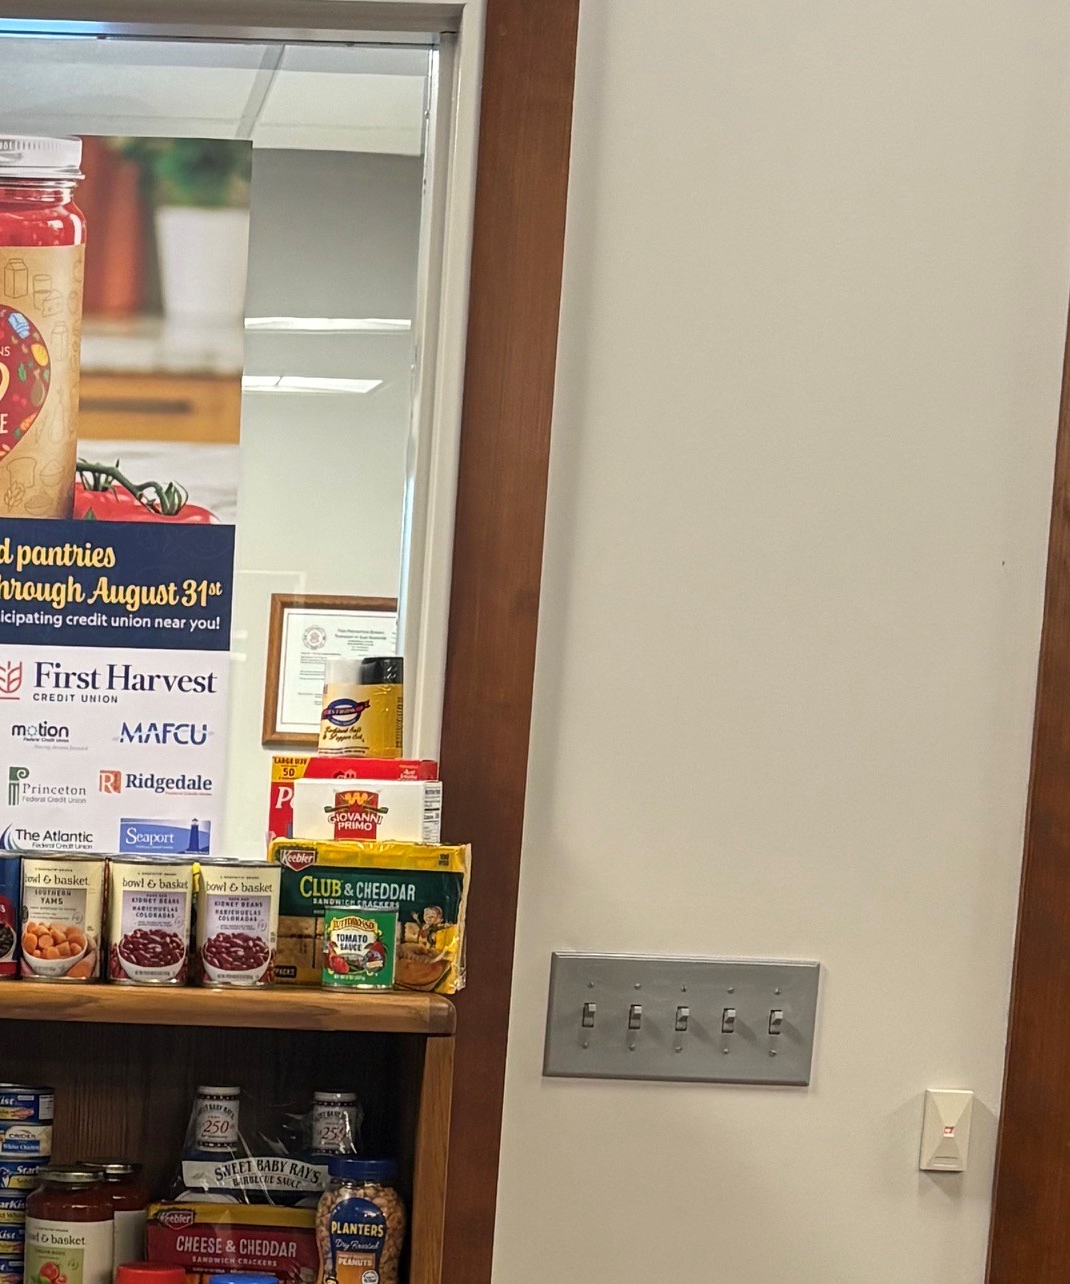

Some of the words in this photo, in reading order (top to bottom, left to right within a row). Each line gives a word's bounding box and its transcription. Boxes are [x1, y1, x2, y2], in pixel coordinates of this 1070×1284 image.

[16, 542, 116, 572] pantries
[87, 576, 179, 612] August
[66, 612, 107, 627] credit
[111, 614, 151, 628] union
[154, 617, 186, 629] near
[190, 617, 220, 632] you!
[34, 661, 102, 690] First
[106, 663, 218, 694] Harvest
[32, 692, 75, 702] CREDIT
[82, 694, 118, 704] UNION
[12, 721, 69, 738] motion
[119, 721, 209, 746] MAFCU
[22, 783, 87, 796] Princeton
[126, 773, 212, 793] Ridgedale
[328, 813, 383, 825] GIOVANNI
[338, 822, 373, 831] PRIMO
[15, 828, 39, 842] The
[42, 829, 93, 843] Atlantic
[126, 827, 173, 845] Seaport
[300, 876, 341, 897] CLUB
[344, 884, 354, 897] &
[356, 882, 416, 901] CHEDDAR
[336, 933, 368, 943] TOMATO
[257, 1158, 286, 1173] BABY
[289, 1164, 321, 1184] RAY'S
[331, 1220, 384, 1238] PLANTERS
[176, 1236, 223, 1254] CHEESE
[226, 1239, 237, 1253] &
[239, 1239, 297, 1258] CHEDDAR
[192, 1255, 235, 1265] SANDWICH
[238, 1257, 277, 1267] CRACKERS
